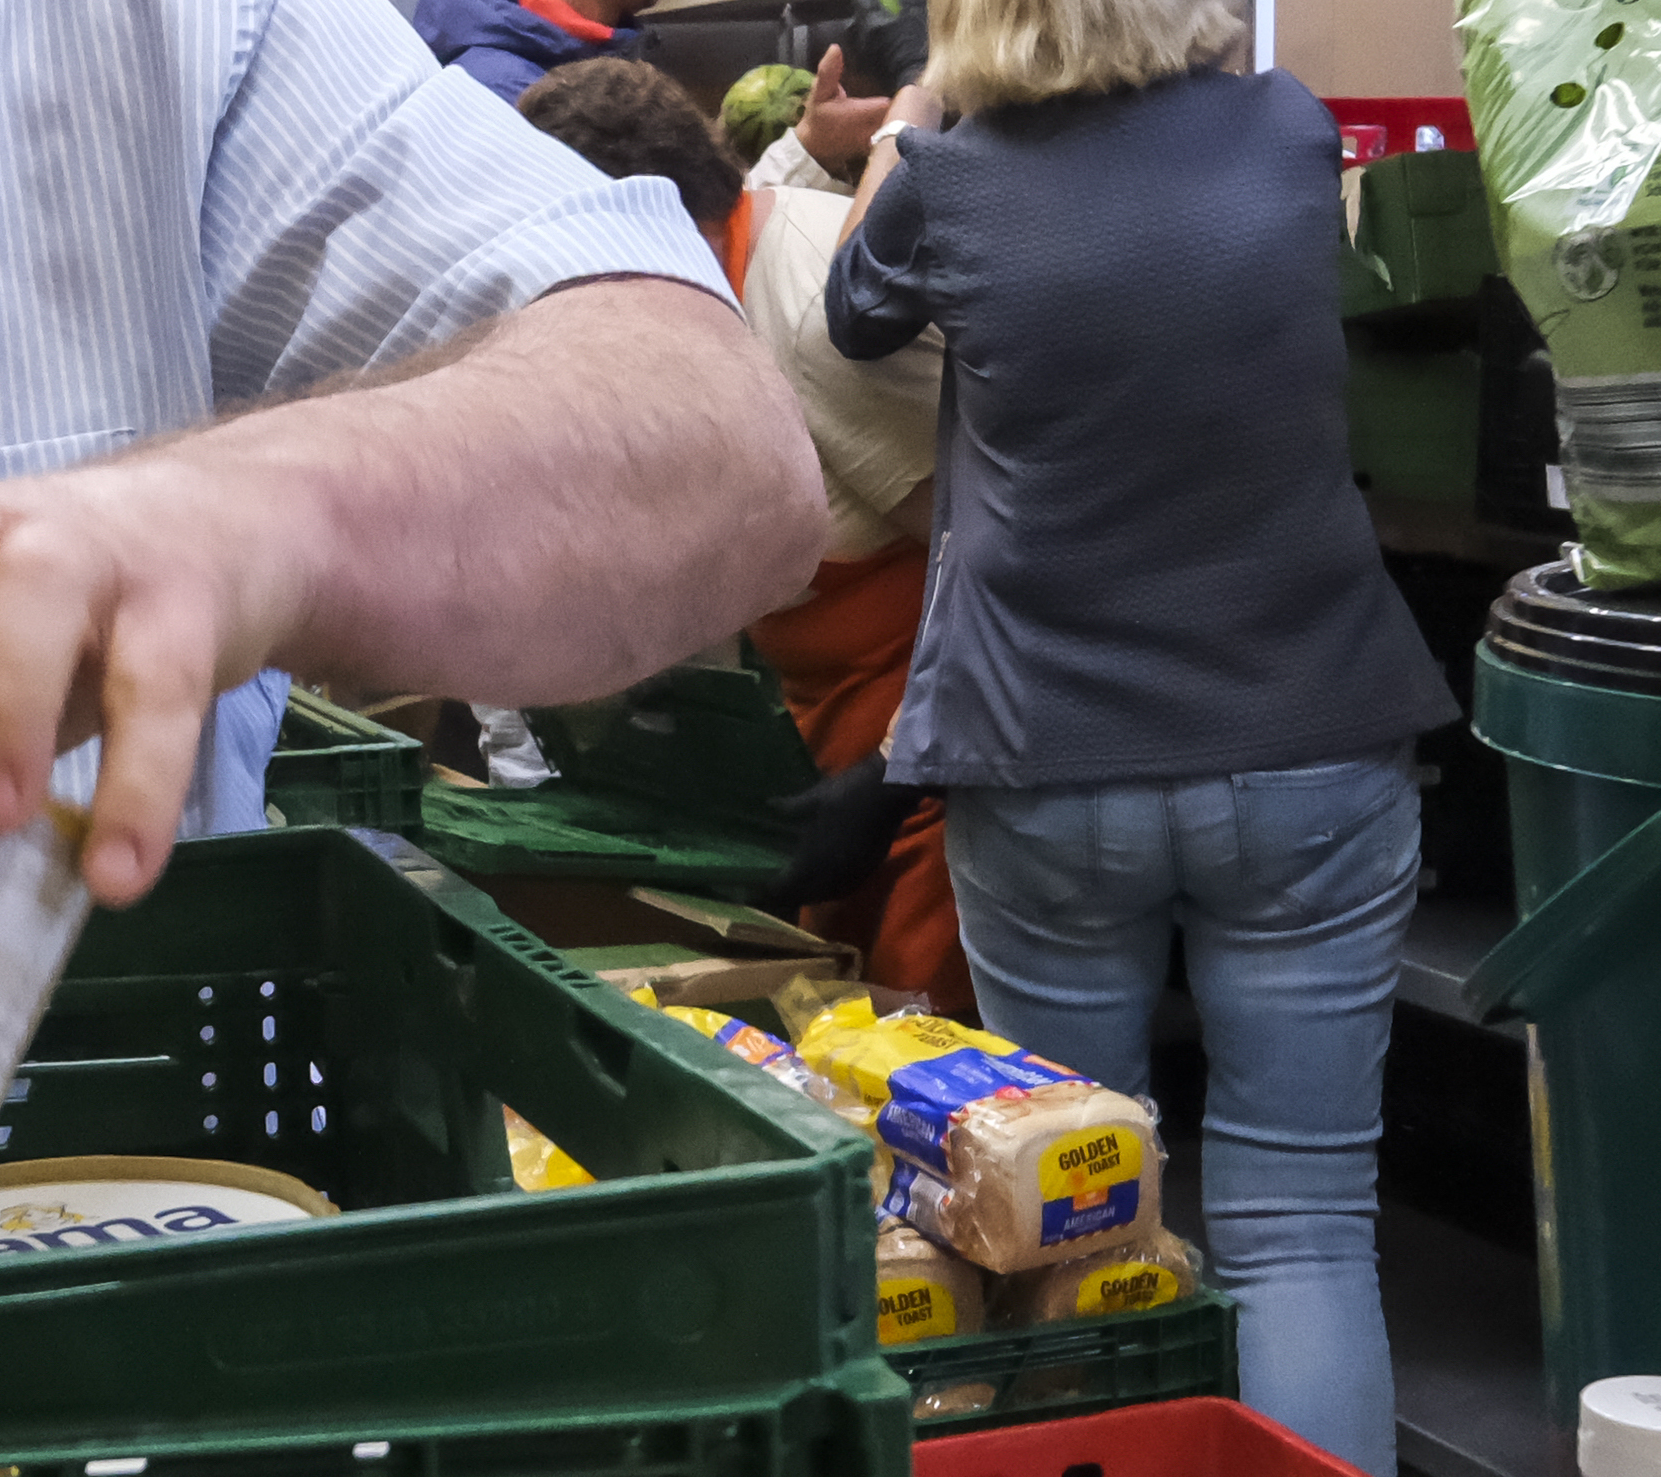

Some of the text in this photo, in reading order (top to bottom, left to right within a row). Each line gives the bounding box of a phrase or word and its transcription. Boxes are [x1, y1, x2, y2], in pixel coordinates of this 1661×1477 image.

[1058, 1132, 1119, 1172] GOLDEN
[1086, 1151, 1121, 1177] TOAST
[879, 1286, 933, 1317] OLDEN
